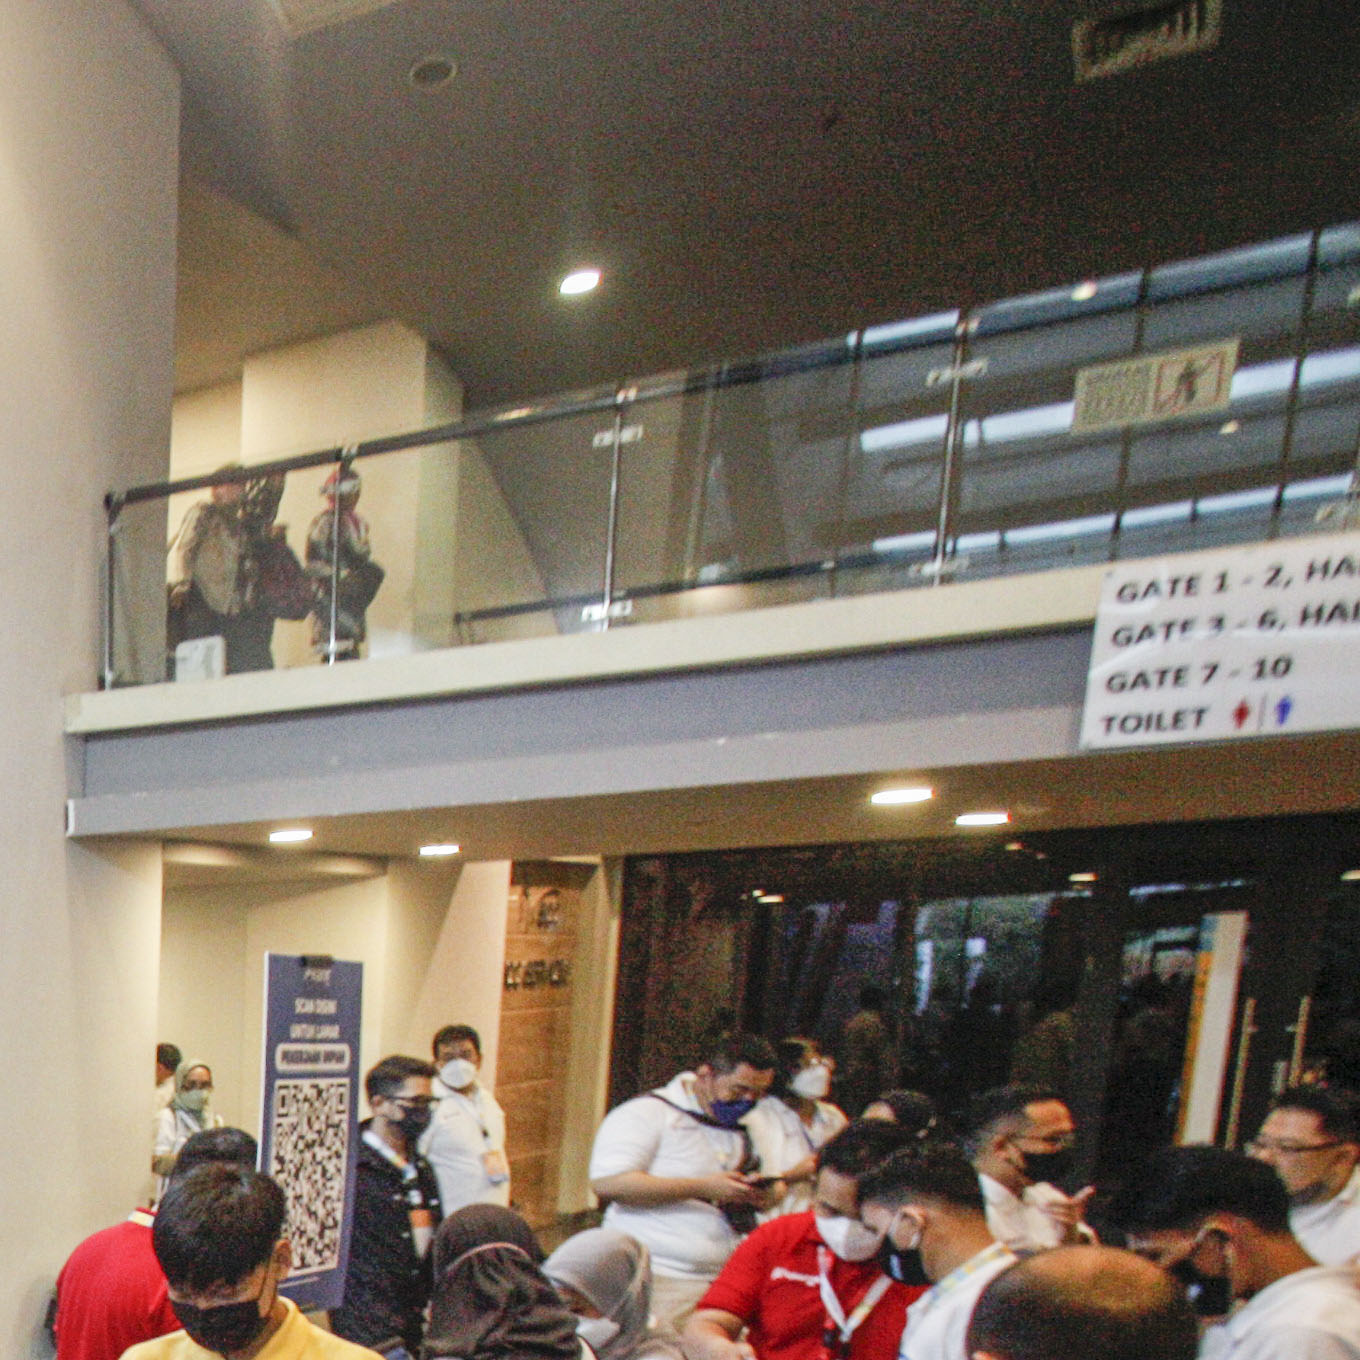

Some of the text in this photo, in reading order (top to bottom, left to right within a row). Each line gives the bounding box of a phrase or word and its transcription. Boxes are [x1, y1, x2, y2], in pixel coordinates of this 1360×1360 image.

[1116, 573, 1201, 604] GATE
[1212, 570, 1229, 593] 1
[1305, 555, 1360, 582] HA
[1110, 616, 1196, 649] GATE
[1105, 663, 1191, 695] GATE
[1200, 661, 1221, 684] 7
[1250, 655, 1294, 682] 10
[1100, 705, 1211, 737] TOILET
